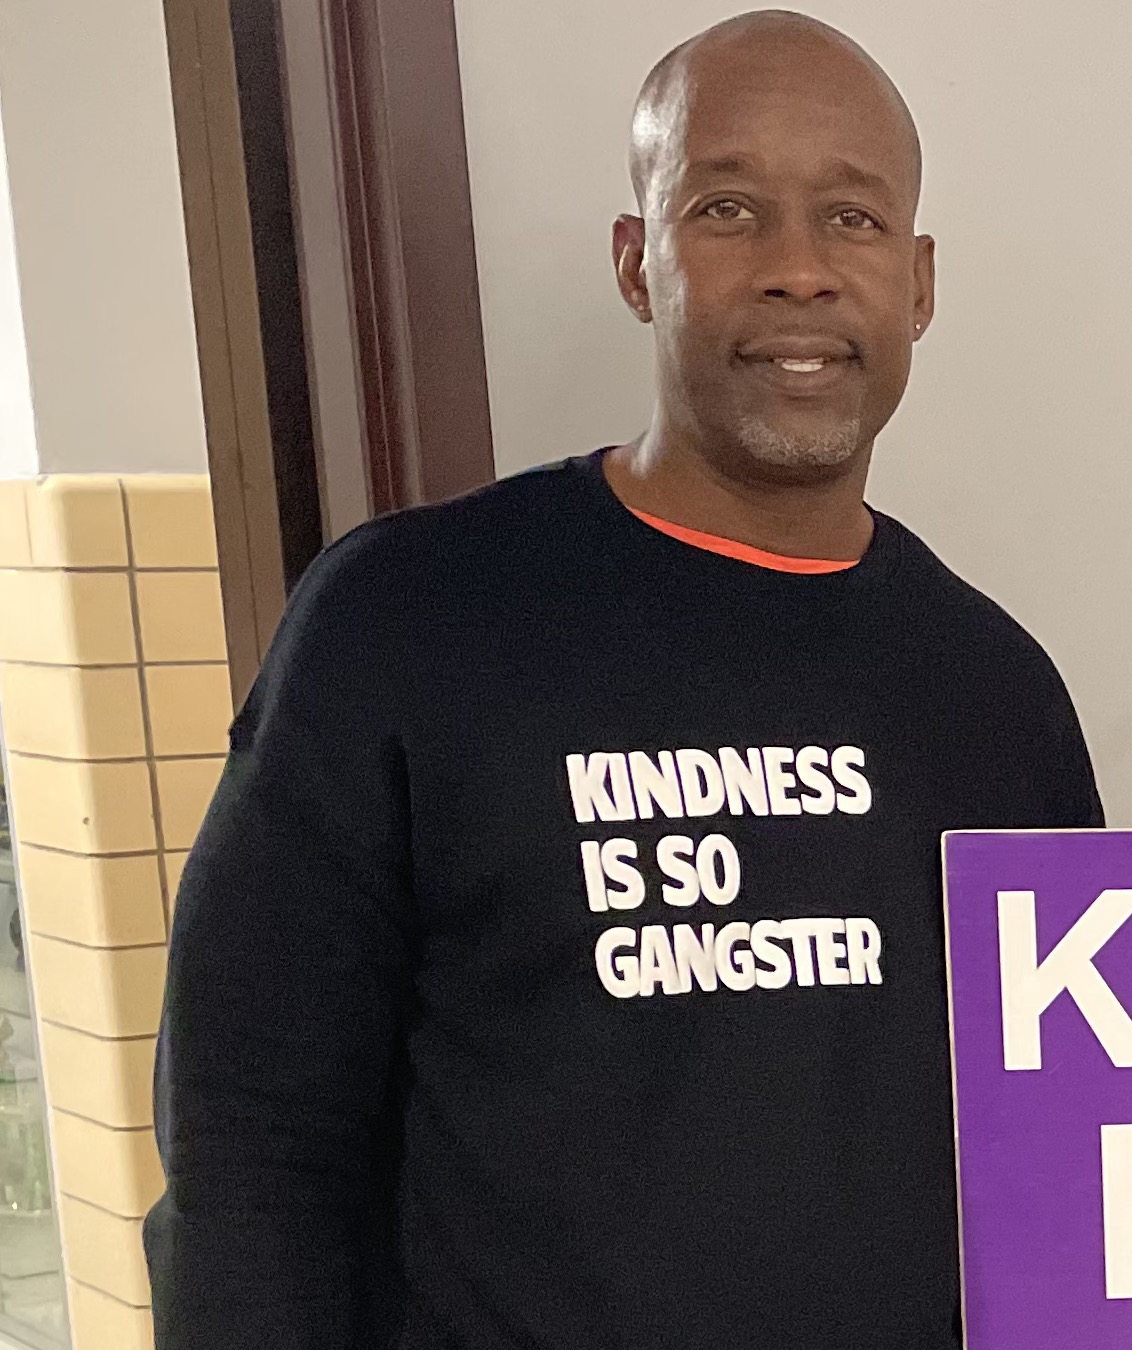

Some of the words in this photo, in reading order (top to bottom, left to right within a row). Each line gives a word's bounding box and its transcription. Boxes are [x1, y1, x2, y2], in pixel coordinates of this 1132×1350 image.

[566, 746, 872, 823] KINDNESS
[580, 837, 646, 912] IS
[656, 834, 741, 907] SO
[595, 917, 883, 999] GANGSTER
